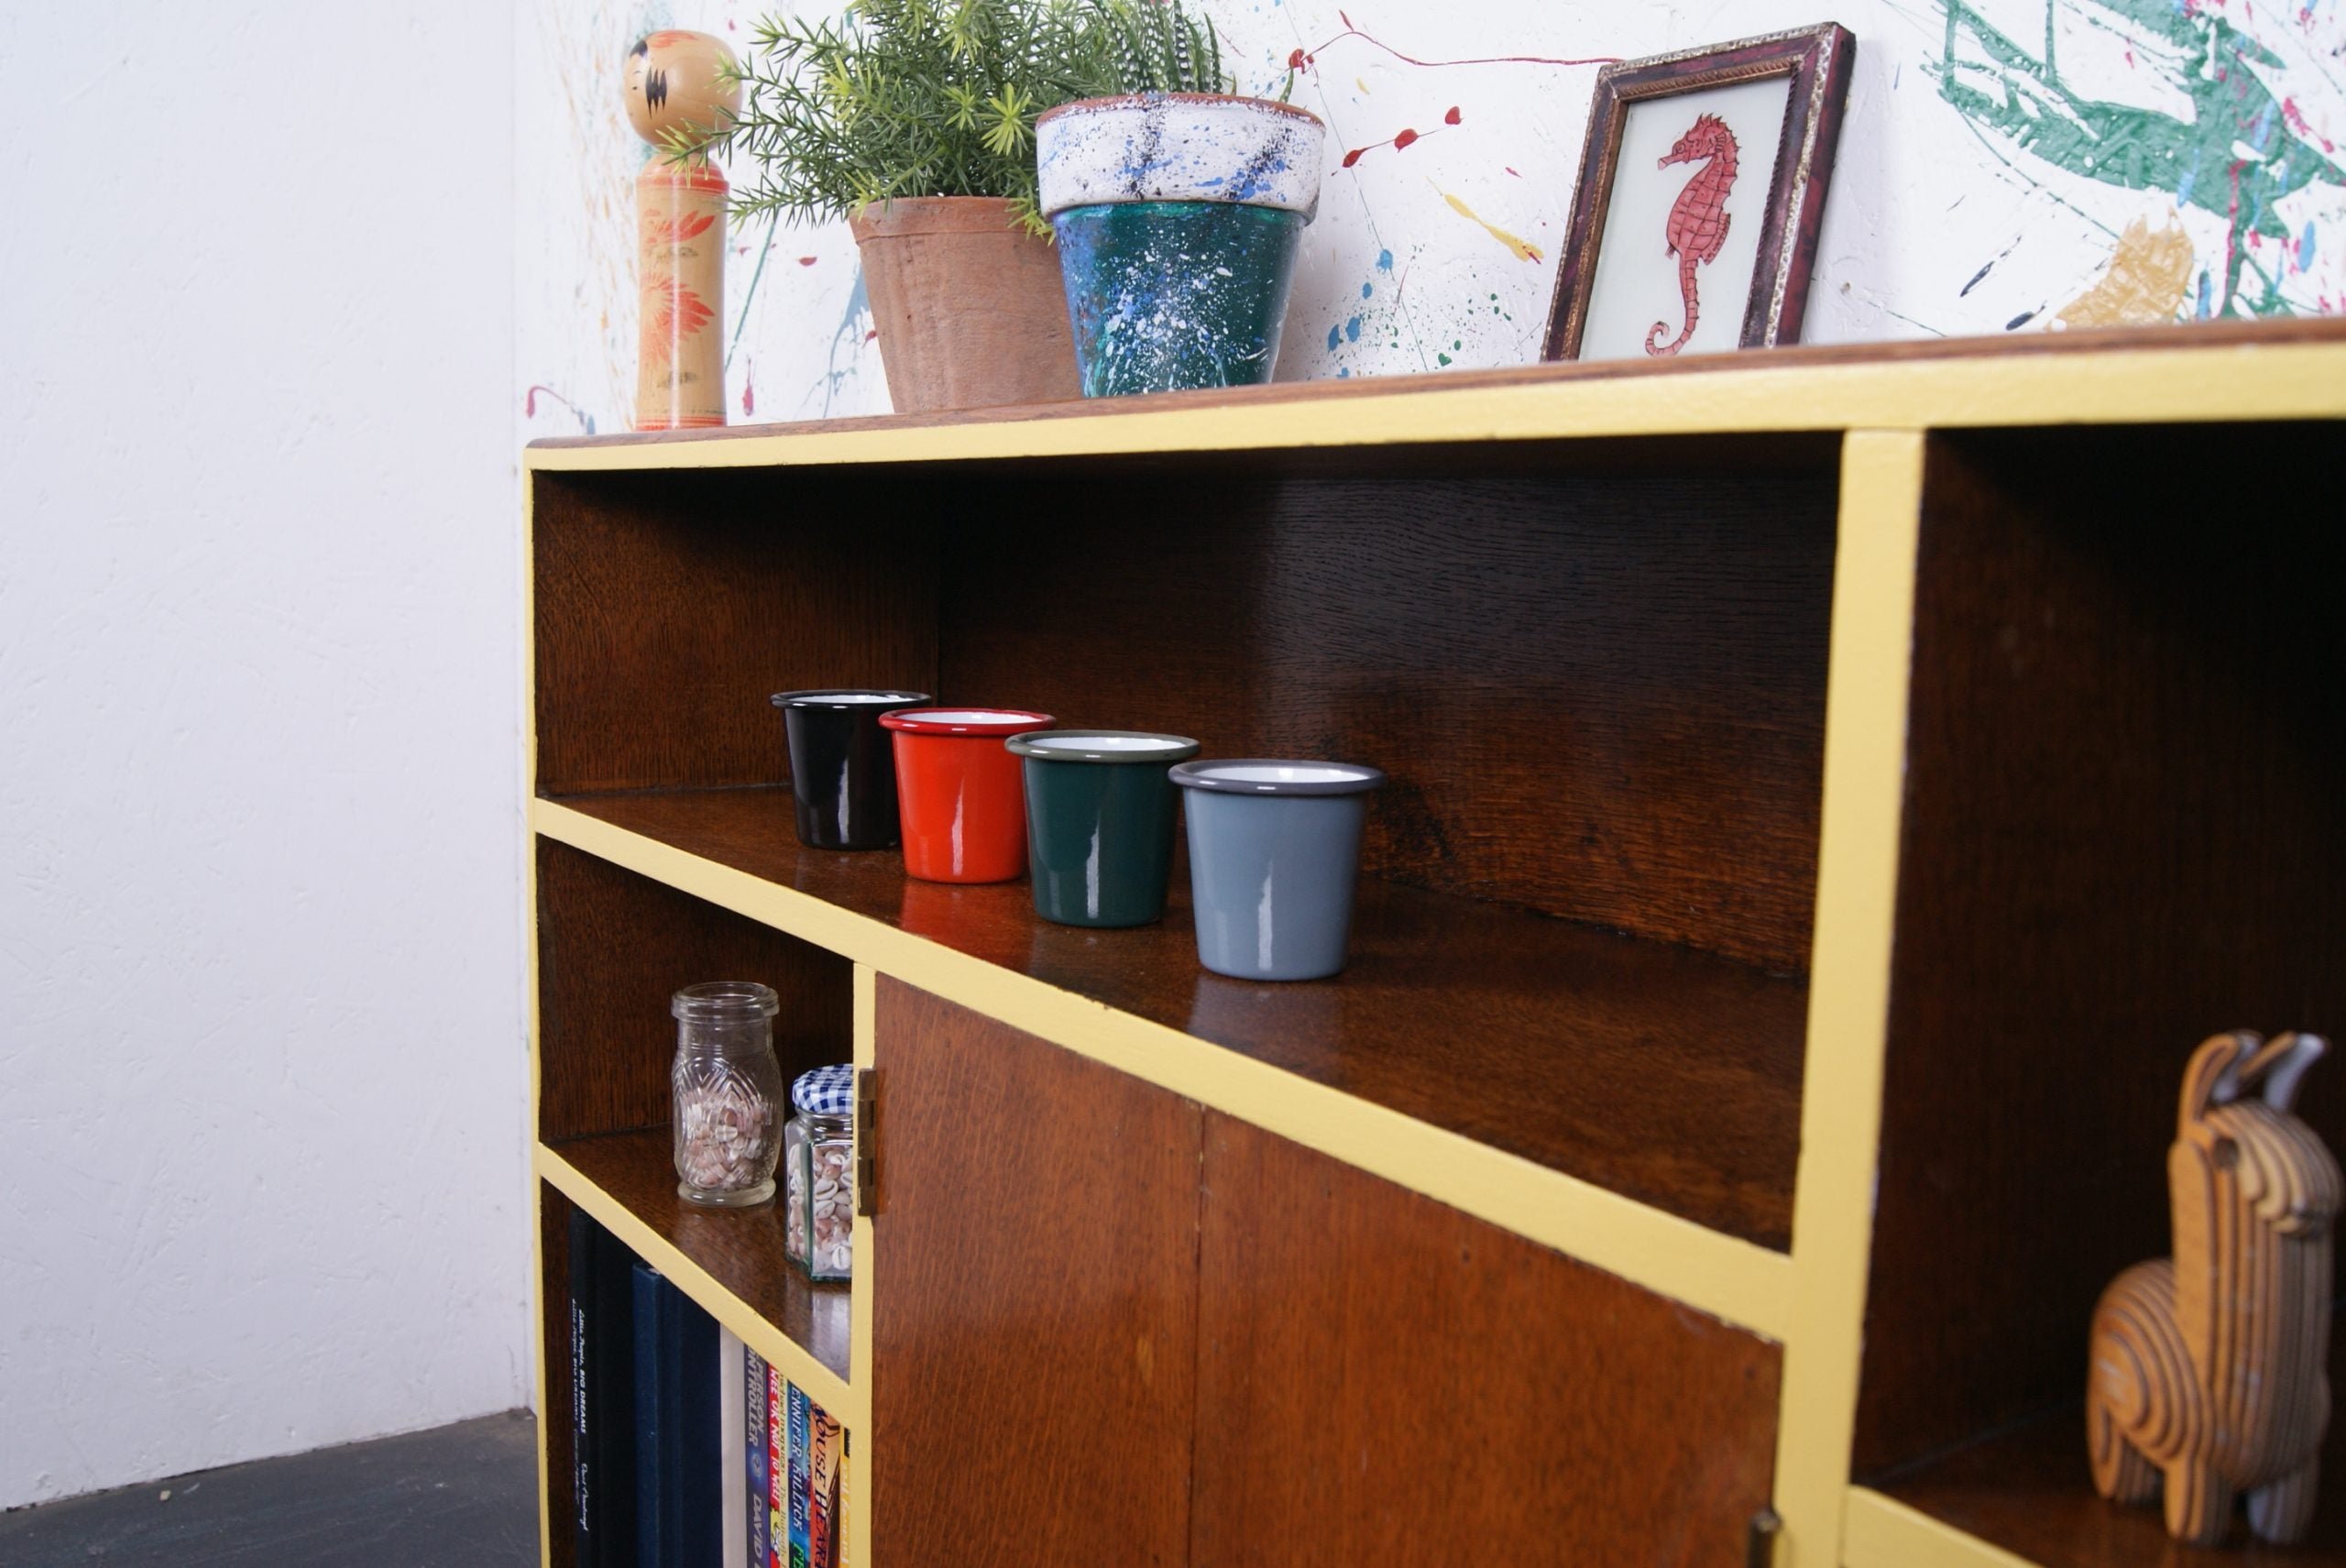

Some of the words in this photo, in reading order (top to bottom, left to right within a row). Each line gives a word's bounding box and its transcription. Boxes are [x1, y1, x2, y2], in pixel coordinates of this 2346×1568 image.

[770, 1368, 779, 1396] WEE
[756, 1361, 765, 1433] PERSON
[771, 1399, 780, 1420] OR
[771, 1422, 780, 1451] NOT
[772, 1455, 780, 1471] TO
[792, 1463, 803, 1532] KILLICK
[753, 1493, 762, 1559] DAVID
